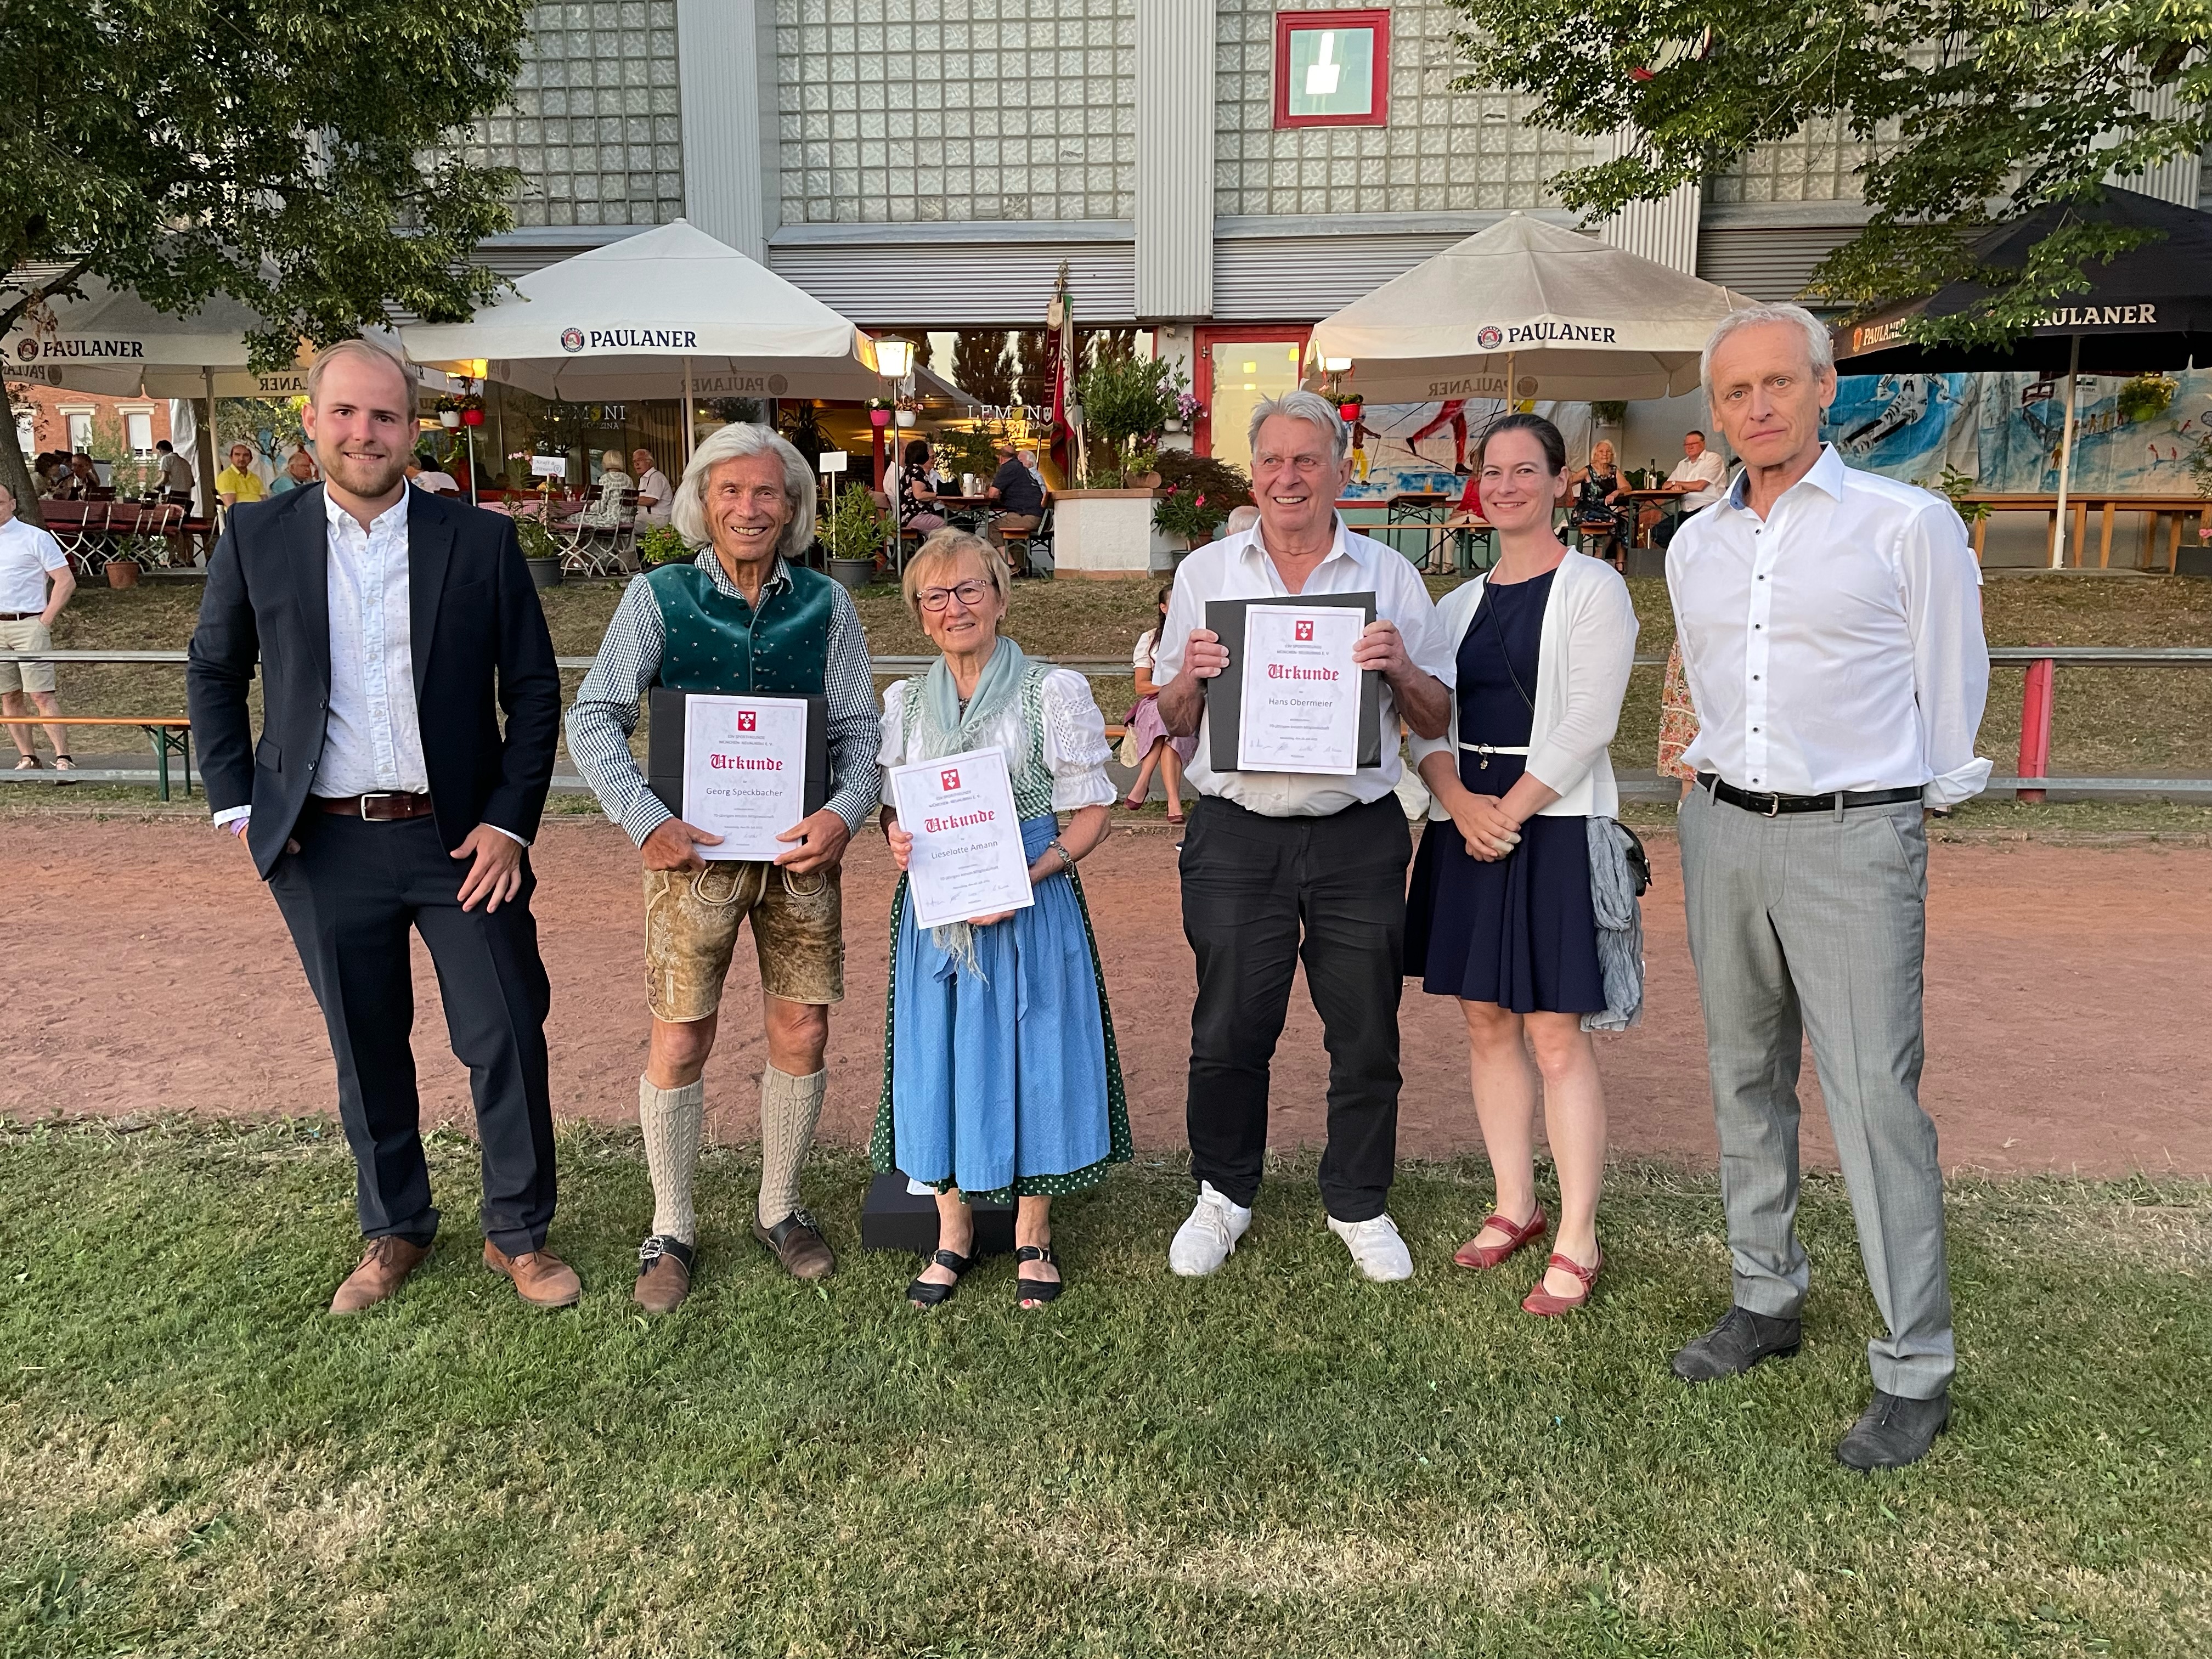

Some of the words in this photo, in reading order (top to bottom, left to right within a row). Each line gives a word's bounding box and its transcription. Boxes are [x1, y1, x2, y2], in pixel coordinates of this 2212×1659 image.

[2021, 303, 2156, 328] AULANER
[590, 330, 697, 347] PAULANER
[1508, 323, 1616, 343] PAULANER
[43, 340, 144, 357] PAULANER
[1268, 664, 1339, 681] Urkunde
[1290, 699, 1333, 707] Obermeier
[710, 754, 783, 770] Urkunde
[706, 787, 730, 797] Georg
[732, 788, 783, 797] Speckbacher
[924, 810, 995, 833] Urkunde
[931, 847, 968, 859] Lieselotte
[970, 840, 998, 851] Amann
